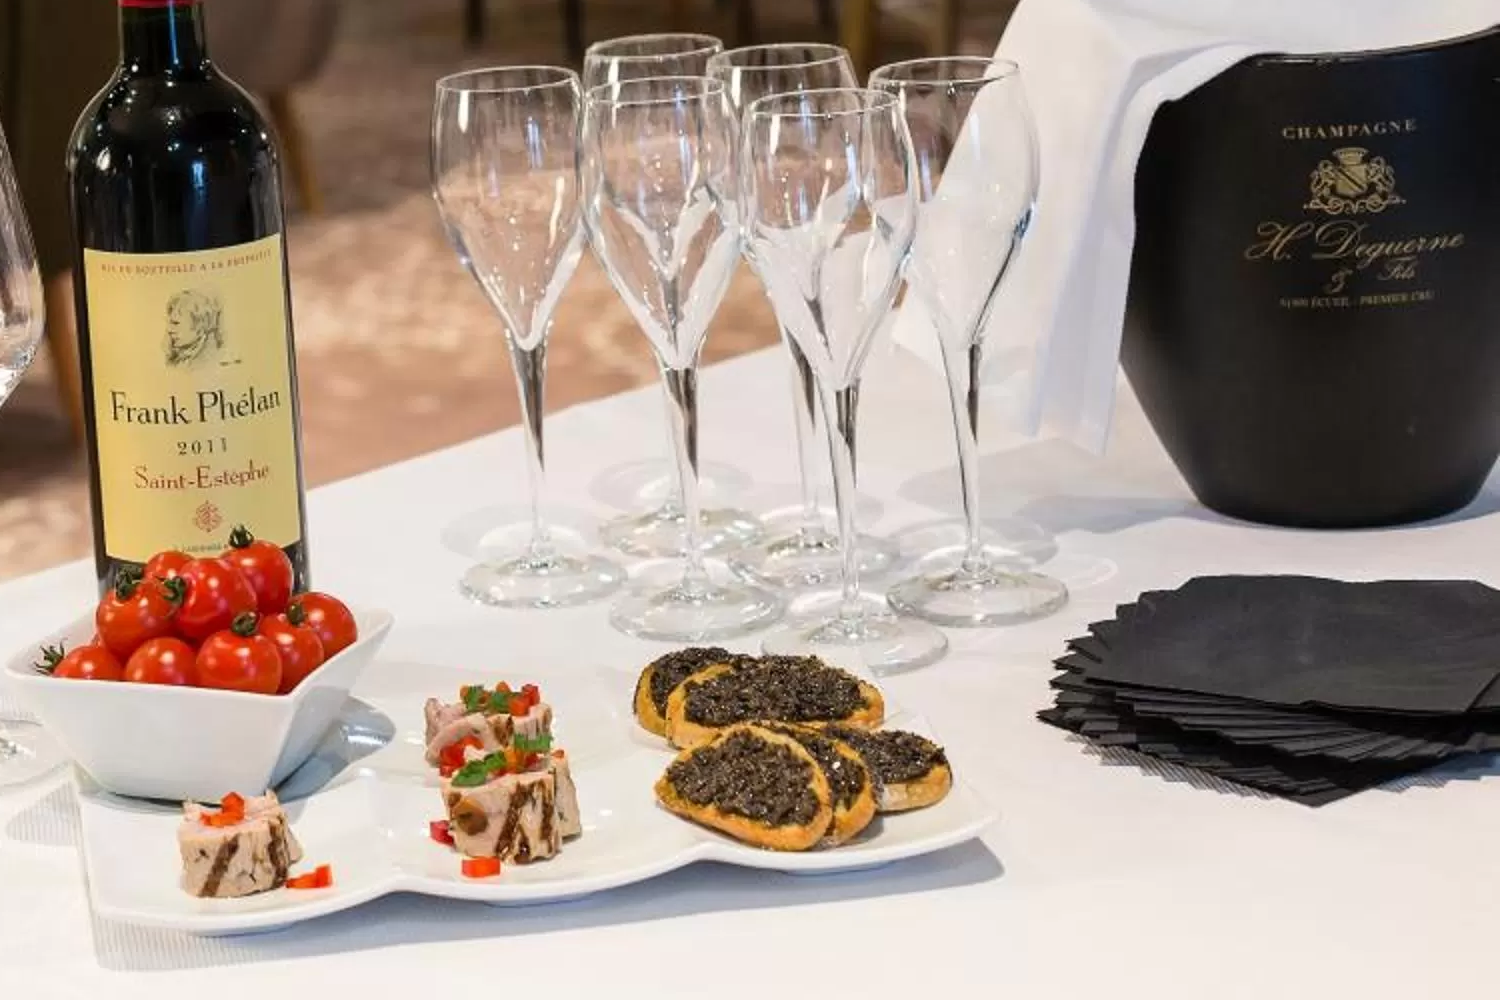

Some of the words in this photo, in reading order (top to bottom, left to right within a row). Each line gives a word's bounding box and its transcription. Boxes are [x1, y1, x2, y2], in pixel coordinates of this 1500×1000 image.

[1282, 118, 1418, 140] CHAMPAGNE
[110, 390, 191, 425] Frank
[198, 385, 282, 424] Phélan
[177, 437, 228, 455] 2011
